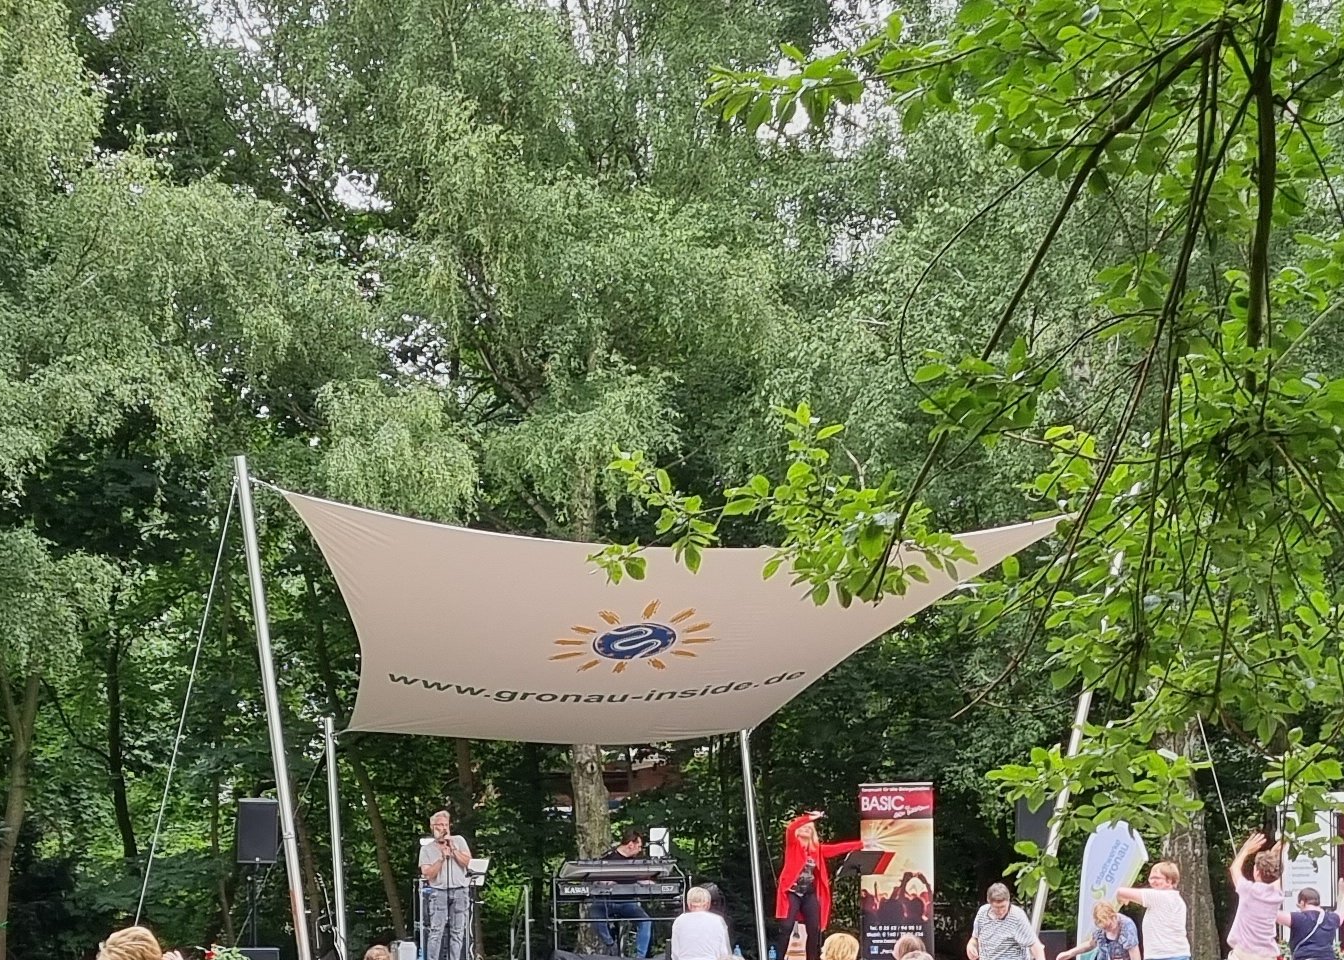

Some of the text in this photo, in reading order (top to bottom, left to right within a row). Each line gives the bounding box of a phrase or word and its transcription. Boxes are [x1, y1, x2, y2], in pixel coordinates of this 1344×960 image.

[389, 671, 806, 703] www.gronau-inside.de
[861, 795, 905, 812] BASIC
[1106, 843, 1129, 884] gronau
